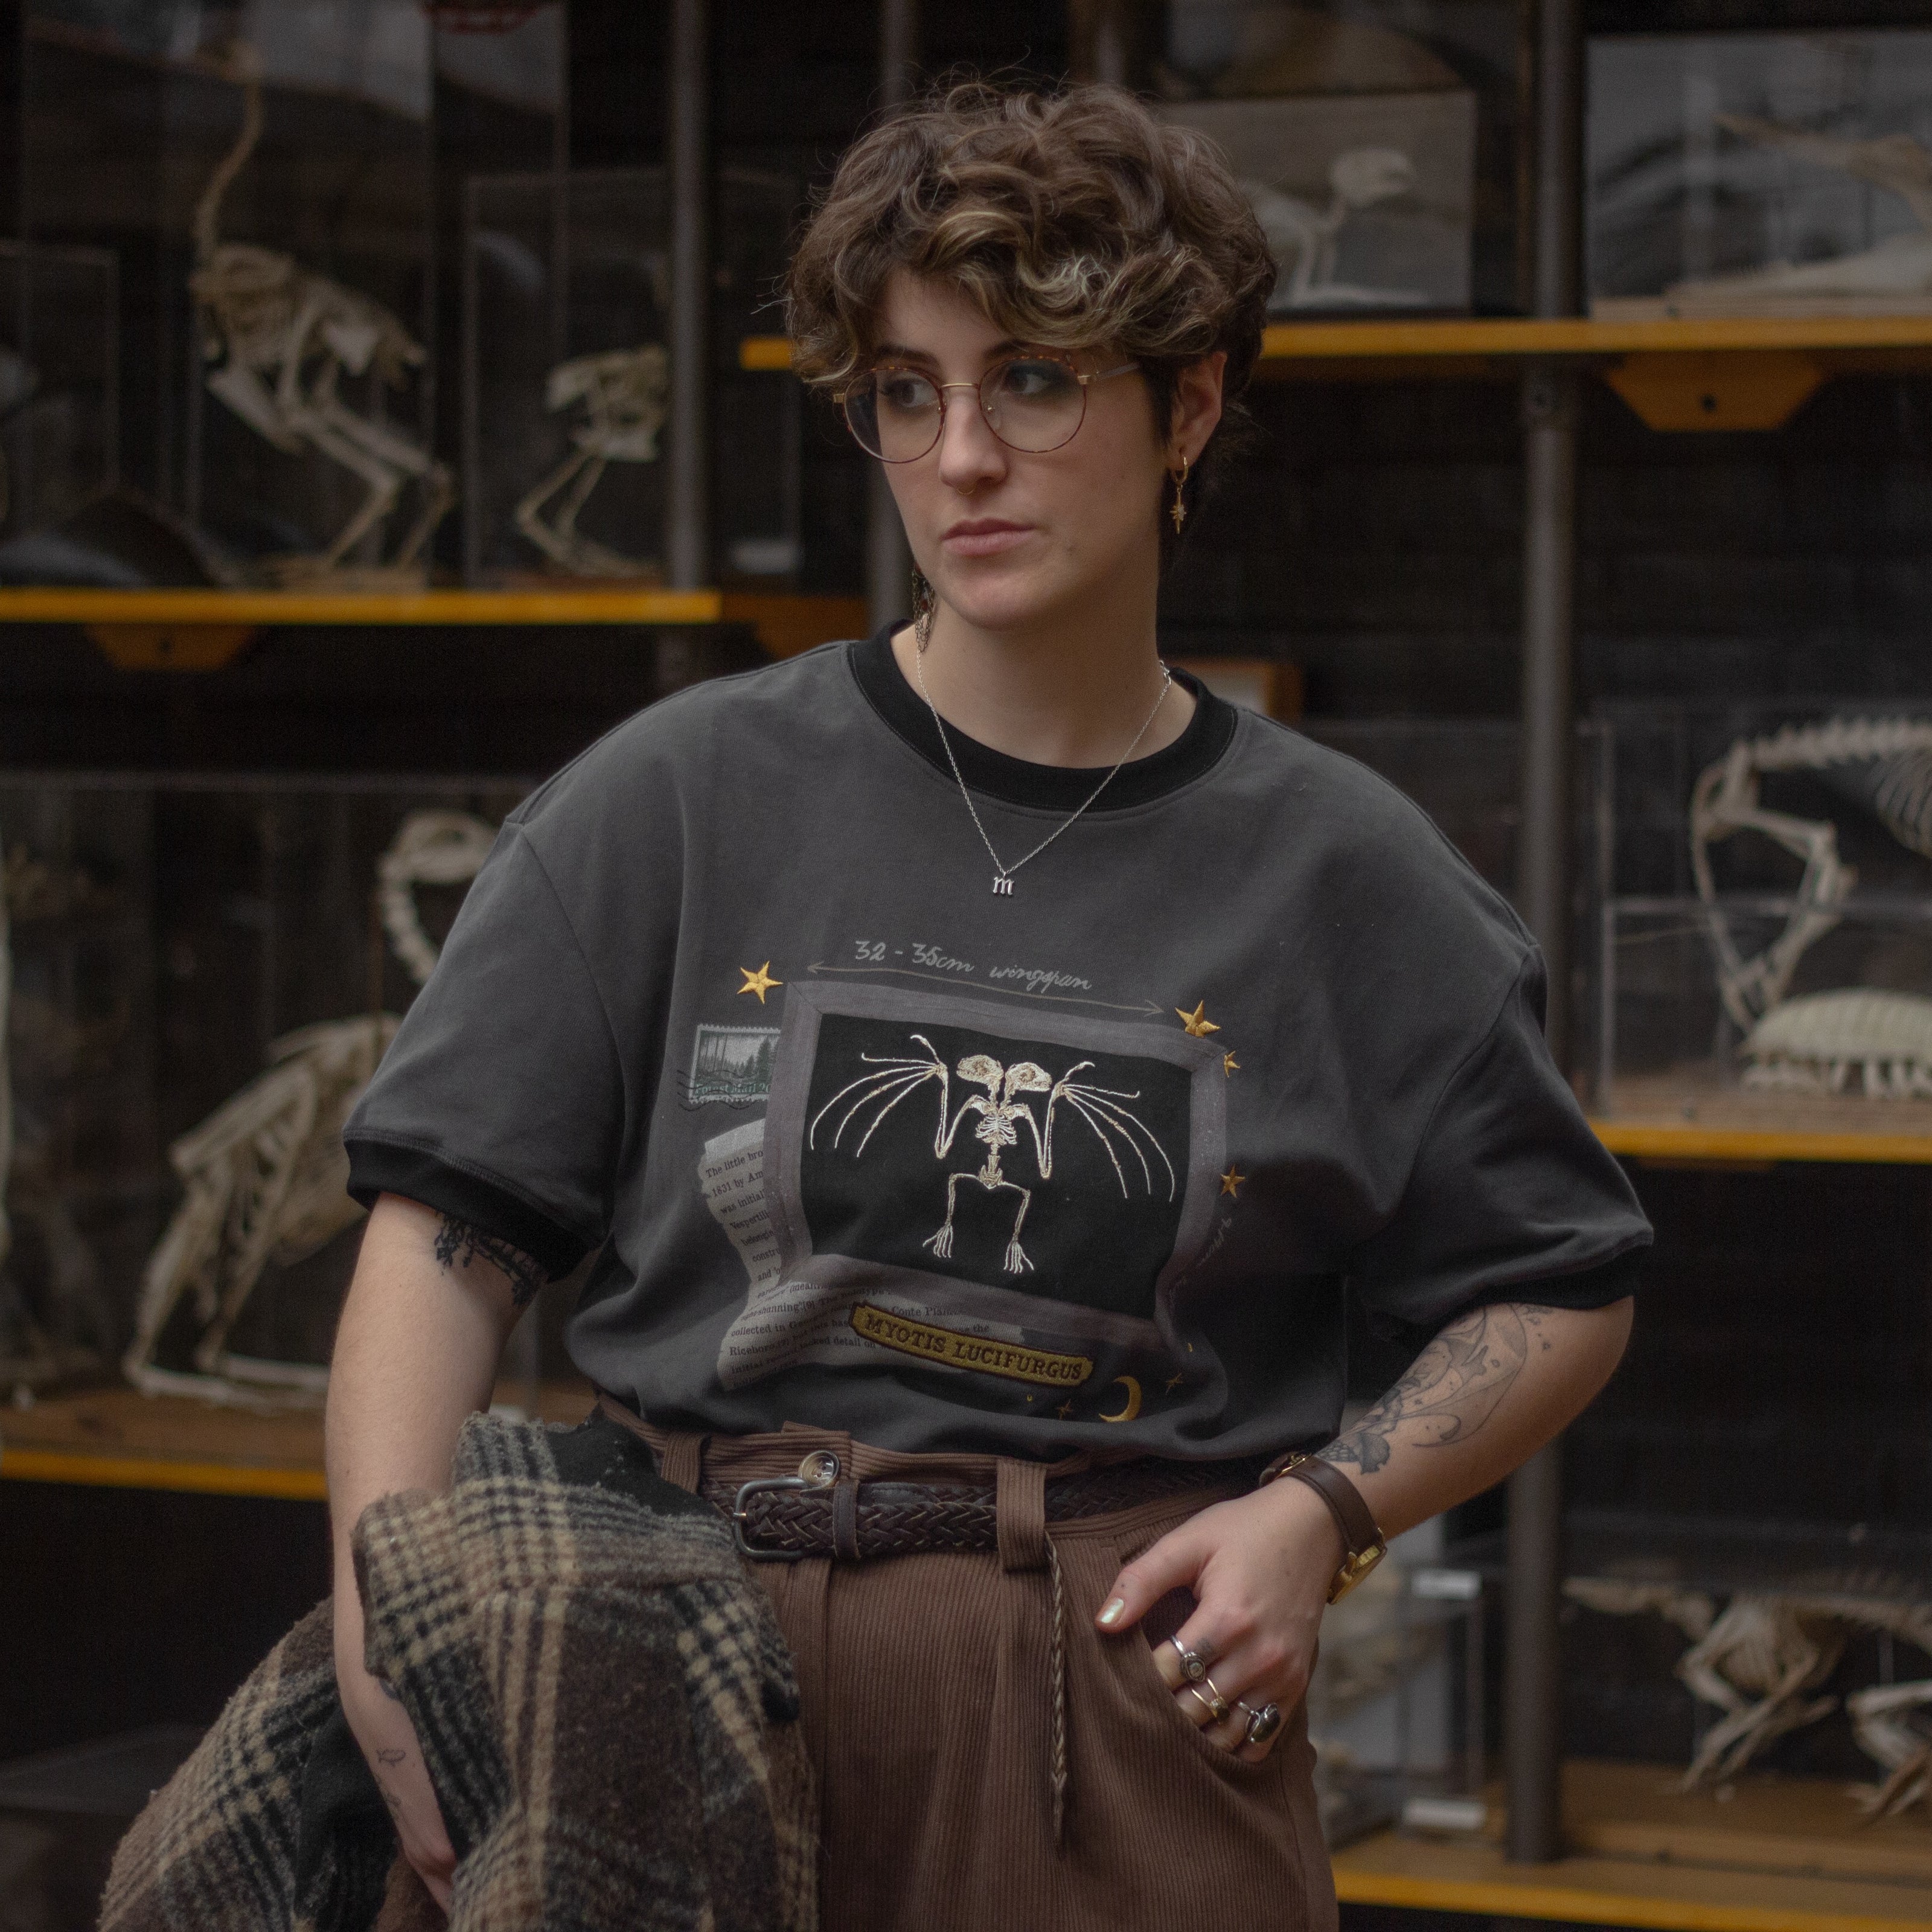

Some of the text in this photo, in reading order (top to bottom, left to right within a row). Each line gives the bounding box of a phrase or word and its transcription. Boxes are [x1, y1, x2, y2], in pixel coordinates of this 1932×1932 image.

[854, 940, 886, 961] 32
[912, 943, 974, 972] 35cm
[990, 965, 1092, 993] wingspan
[705, 1150, 764, 1178] The little bro
[712, 1182, 732, 1197] 1831
[734, 1179, 744, 1188] by
[720, 1203, 737, 1214] was
[758, 1268, 772, 1281] and
[731, 1323, 772, 1337] collected
[775, 1323, 785, 1332] in
[892, 1305, 921, 1316] Conte
[973, 1323, 990, 1332] the
[833, 1335, 861, 1347] detail
[864, 1340, 876, 1349] on
[865, 1314, 1084, 1380] MYOTIS LUCIFURGUS
